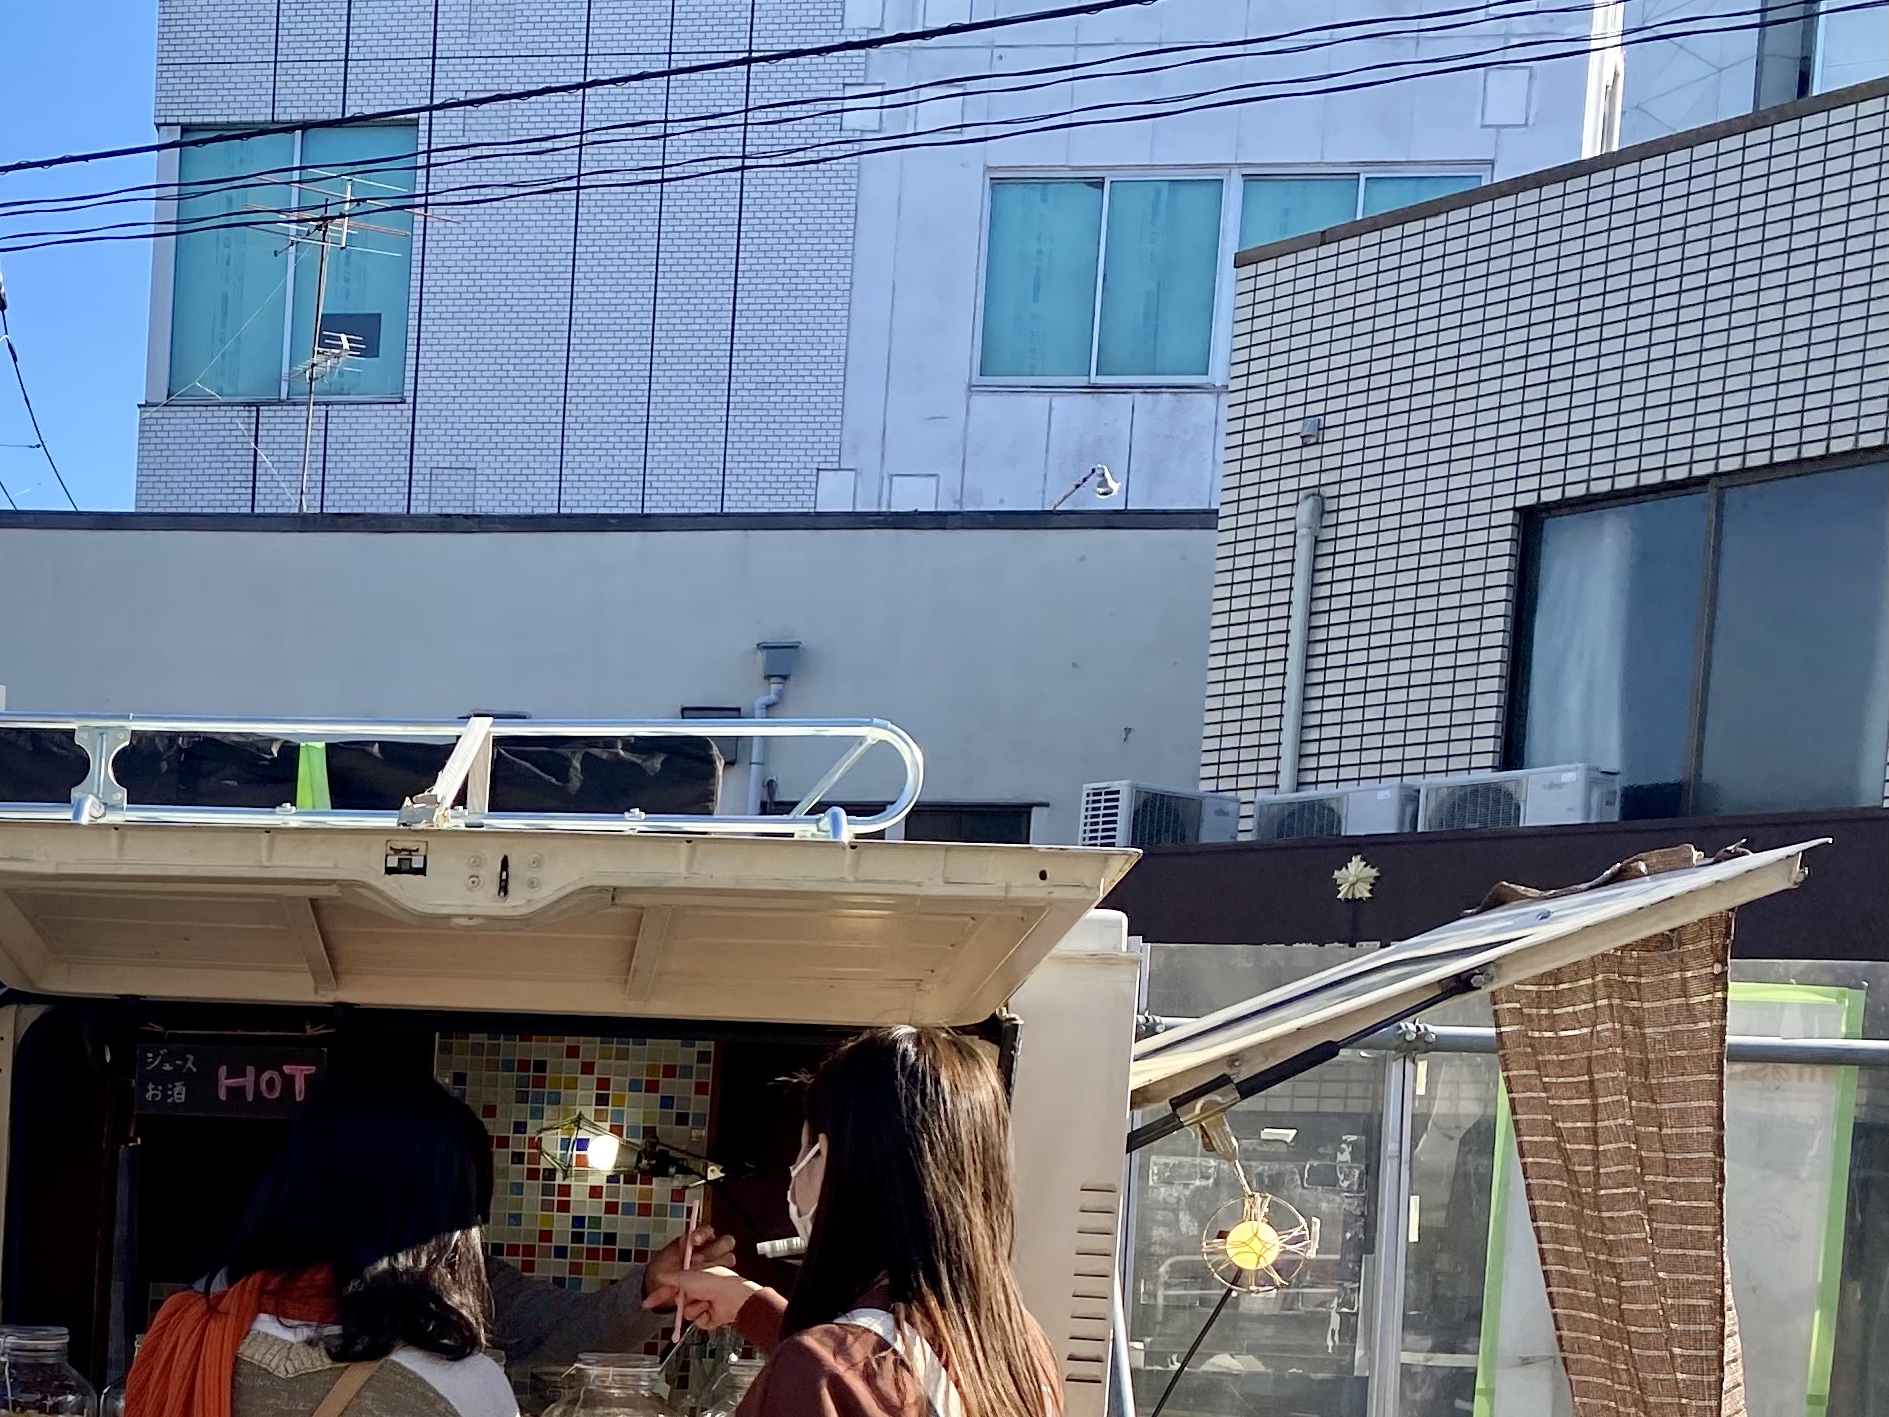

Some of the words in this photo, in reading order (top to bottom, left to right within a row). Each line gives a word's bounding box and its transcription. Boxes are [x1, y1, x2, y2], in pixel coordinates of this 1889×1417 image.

[145, 1048, 198, 1074] ジュース
[144, 1080, 187, 1104] お酒
[217, 1064, 317, 1102] HOT
